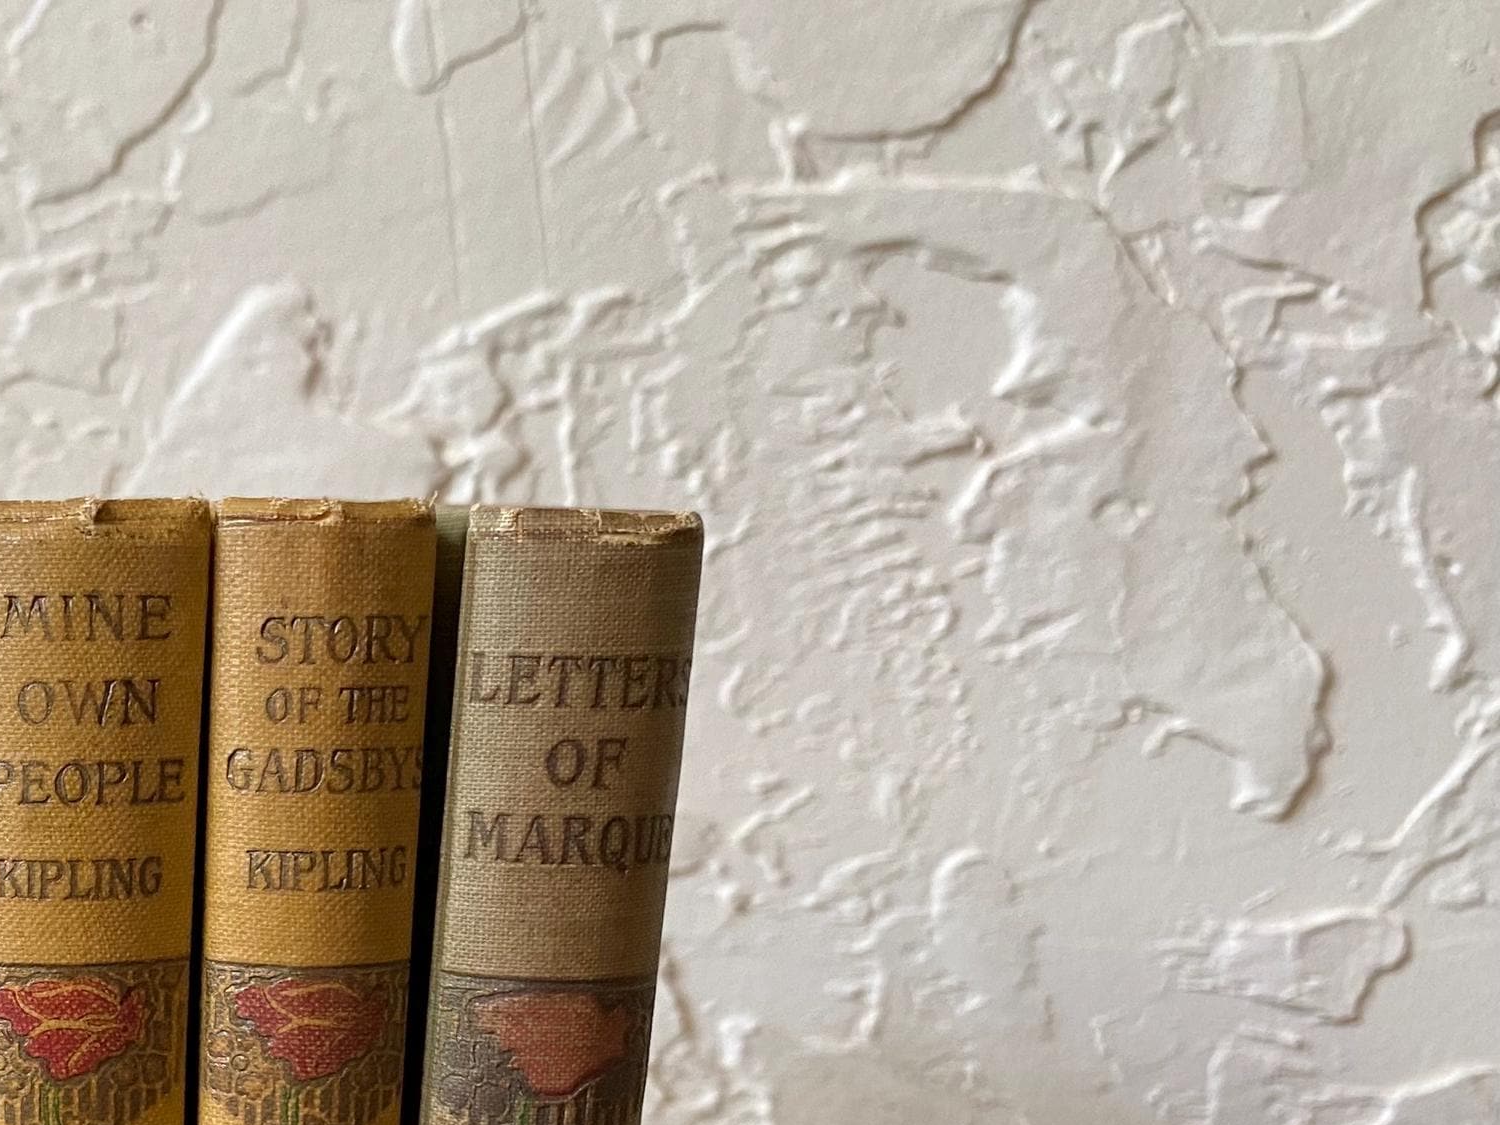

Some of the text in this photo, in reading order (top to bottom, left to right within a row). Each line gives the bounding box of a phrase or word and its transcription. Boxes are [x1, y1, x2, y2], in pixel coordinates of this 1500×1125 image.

[0, 594, 172, 642] MINE
[256, 614, 429, 665] STORY
[17, 679, 161, 727] OWN
[266, 686, 409, 725] OF THE
[544, 737, 629, 790] OF
[246, 847, 407, 893] KIPLING
